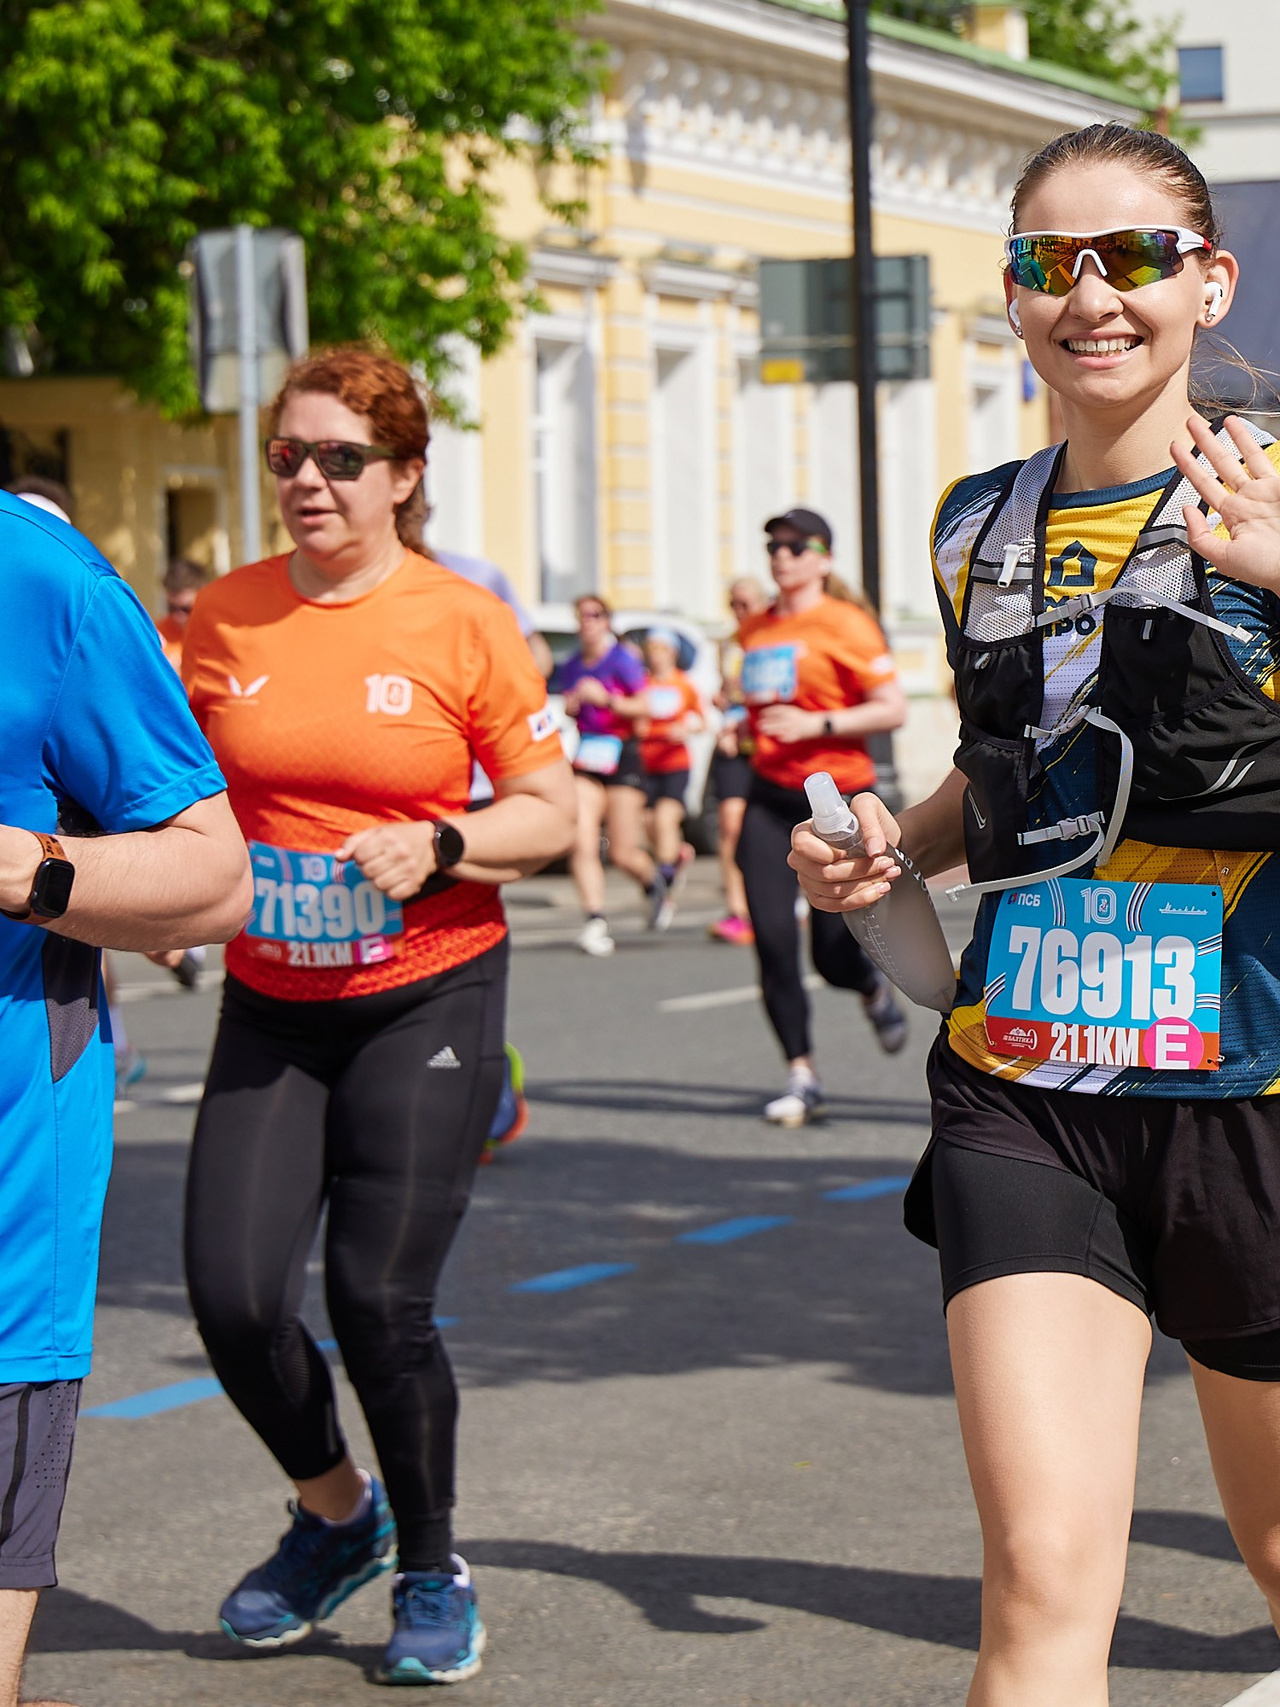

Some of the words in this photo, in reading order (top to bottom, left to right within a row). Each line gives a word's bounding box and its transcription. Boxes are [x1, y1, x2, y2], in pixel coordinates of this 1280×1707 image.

[364, 673, 413, 716] 10
[300, 856, 327, 882] 10
[255, 877, 386, 939] 71390
[1018, 892, 1041, 907] ПСБ
[1080, 886, 1117, 924] 10
[1008, 924, 1196, 1021] 76913
[1049, 1021, 1140, 1067] 21.1KM
[1153, 1024, 1190, 1069] E
